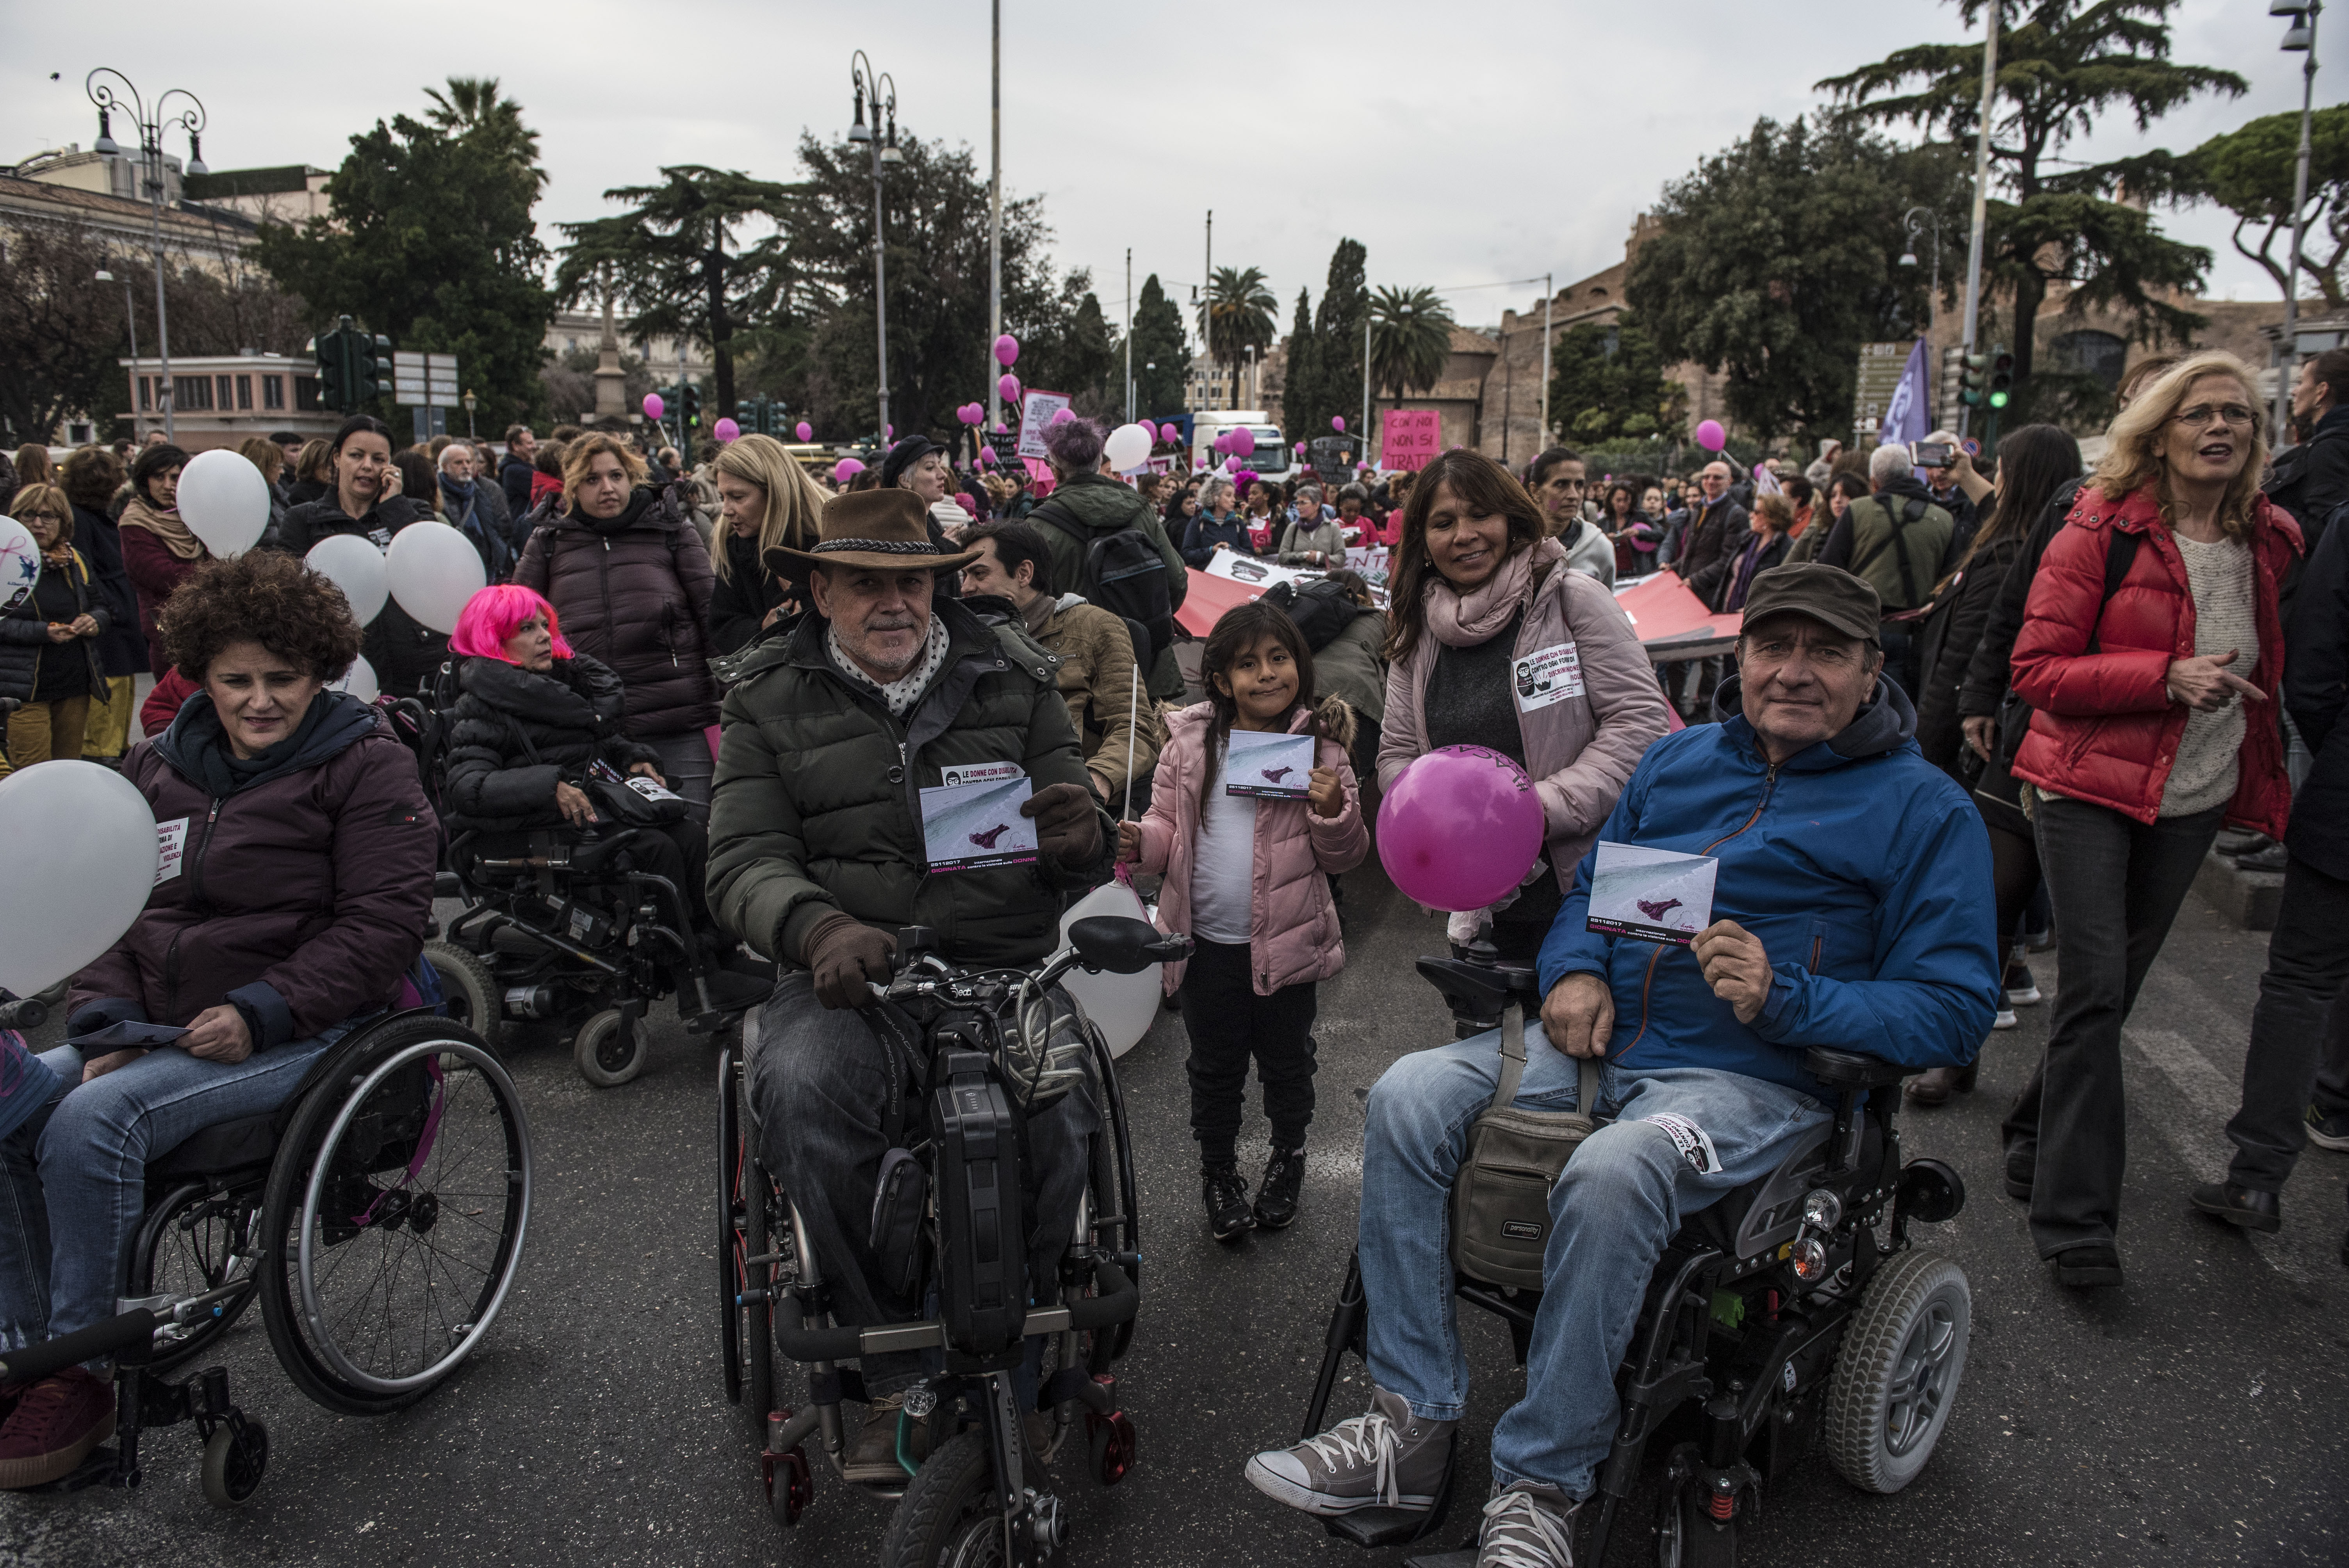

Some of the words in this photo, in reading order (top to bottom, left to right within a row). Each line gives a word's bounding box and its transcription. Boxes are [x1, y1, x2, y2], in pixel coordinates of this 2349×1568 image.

[1390, 417, 1410, 428] CON
[1416, 417, 1433, 427] NOI
[1392, 434, 1413, 447] NON
[1419, 433, 1433, 446] SI
[1535, 654, 1550, 663] DONNE
[1531, 663, 1548, 674] CONTRO
[970, 769, 987, 778] DONNE
[988, 767, 998, 776] CON
[163, 851, 182, 862] VIOLENZA
[1590, 918, 1622, 926] 25112017
[1590, 924, 1627, 934] GIORNATA
[875, 1007, 924, 1069] PIQUADRO
[881, 1034, 897, 1115] PIQUADRO
[1660, 1123, 1680, 1138] DONNE
[1671, 1126, 1691, 1148] CONTRO
[1677, 1139, 1685, 1147] LE
[1510, 1224, 1538, 1234] personality
